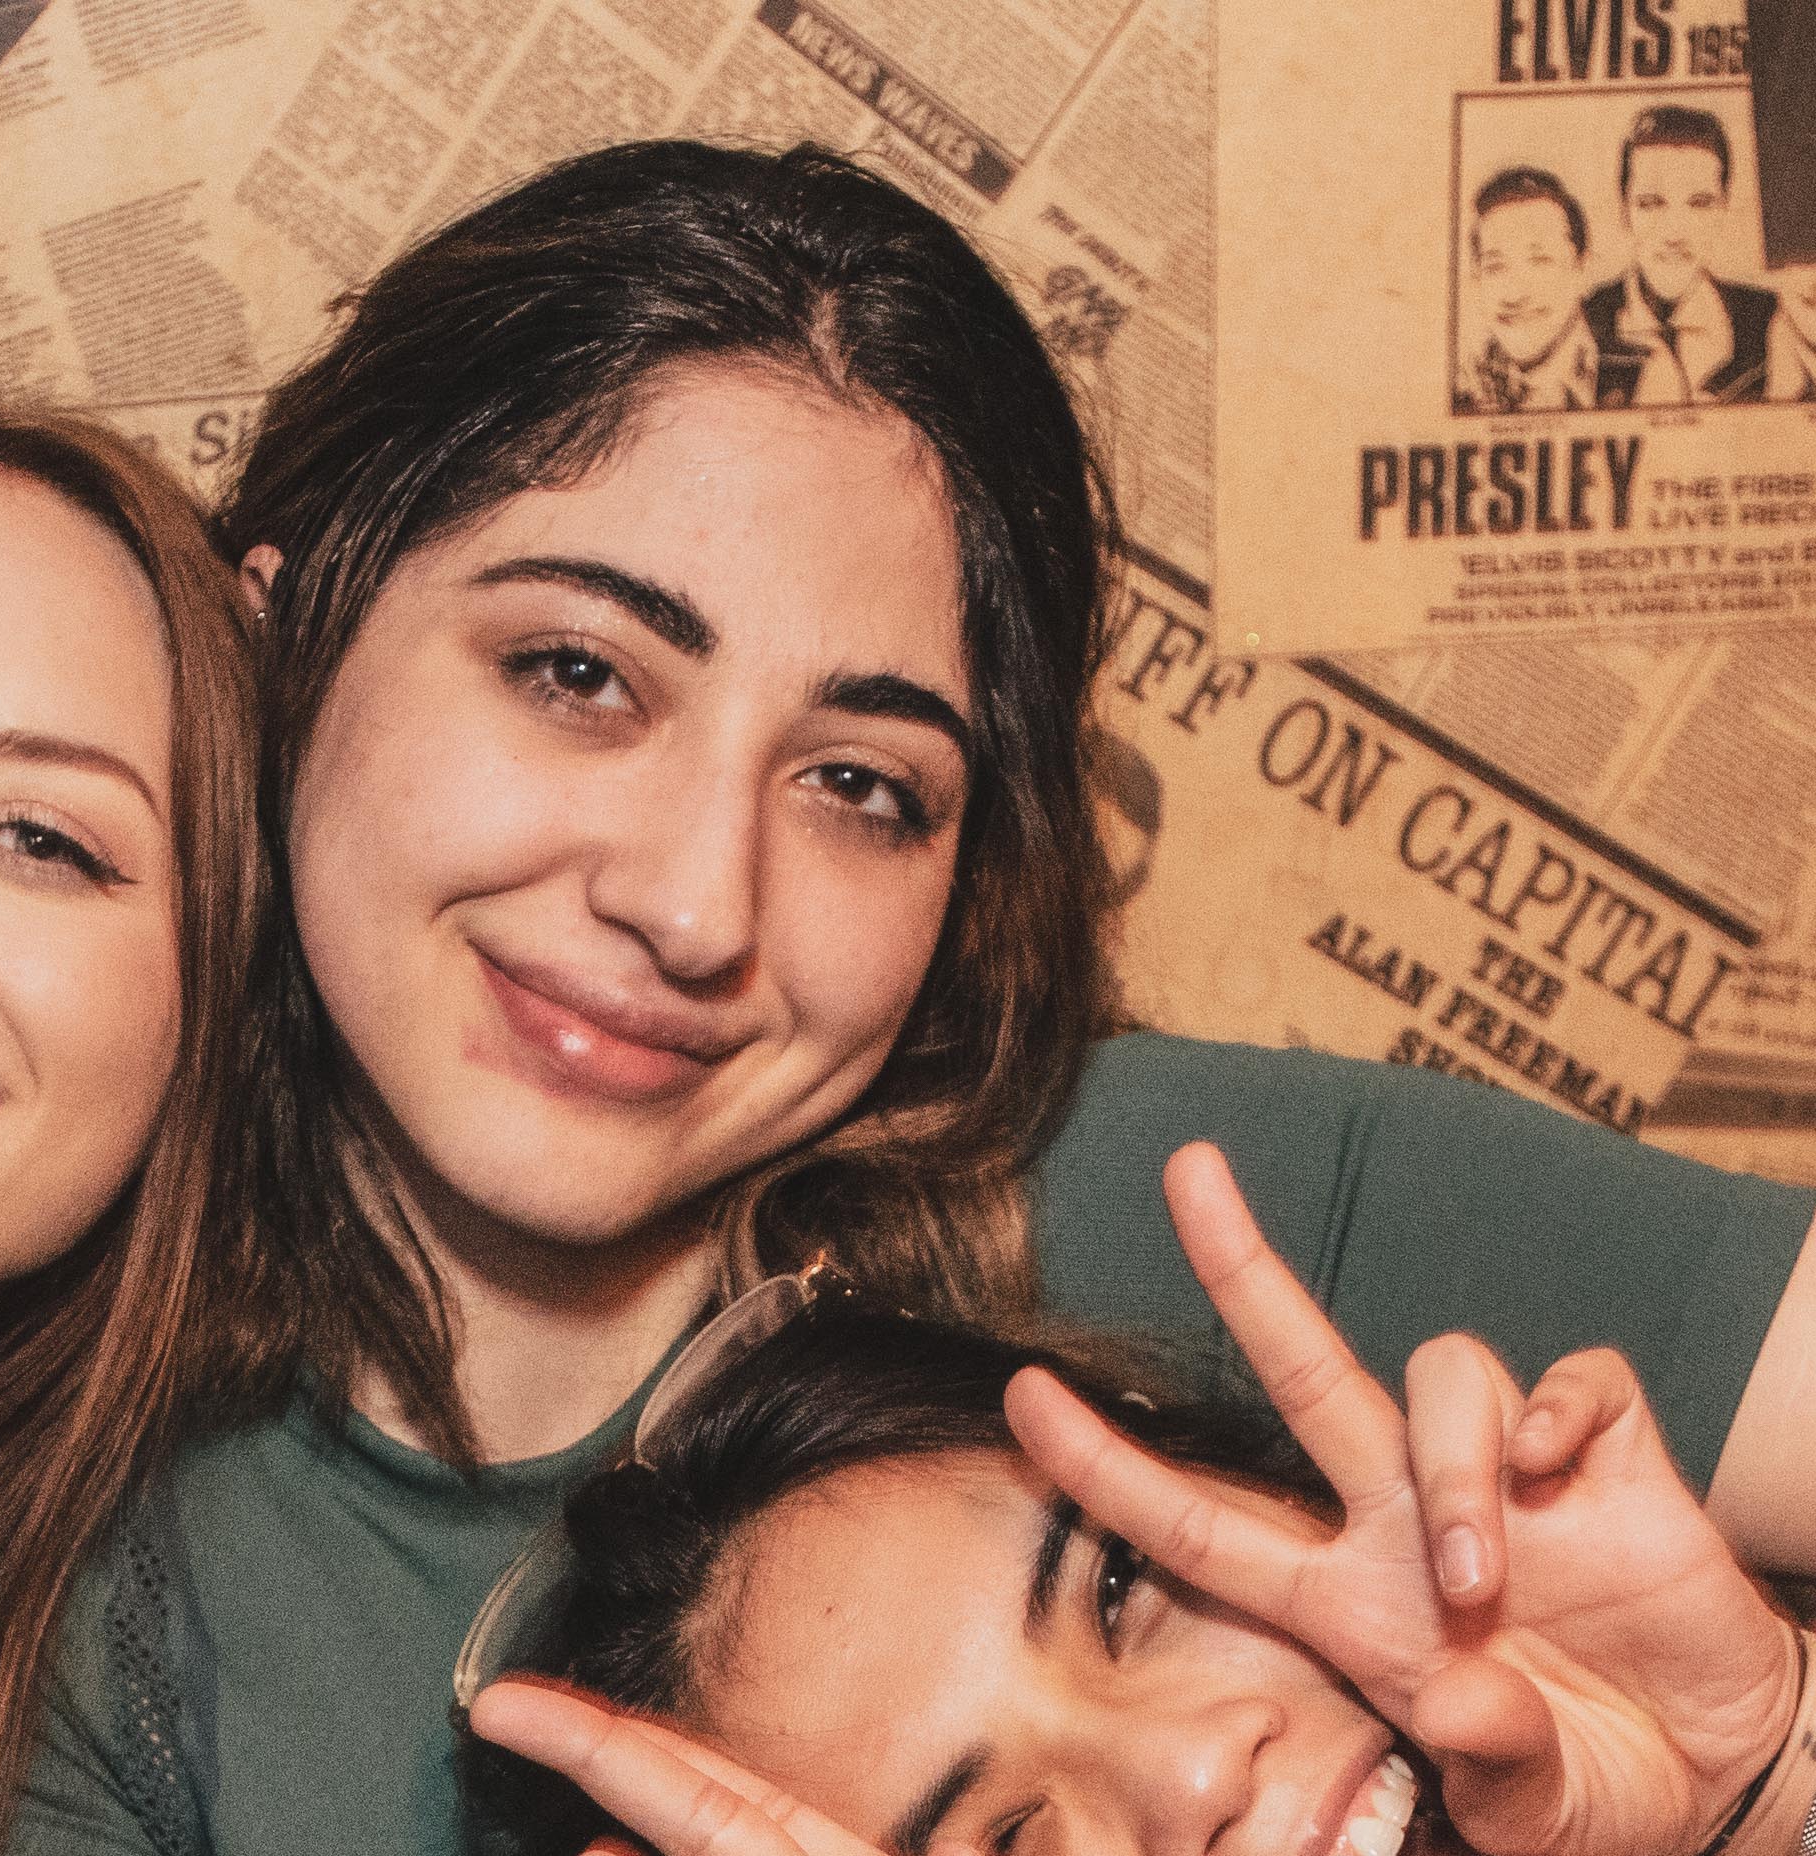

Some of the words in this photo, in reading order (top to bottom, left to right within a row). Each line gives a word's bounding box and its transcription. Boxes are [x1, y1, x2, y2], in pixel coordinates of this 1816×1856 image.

[1496, 0, 1672, 82] ELVIS
[787, 11, 883, 94] NEWS
[877, 78, 981, 171] WAVES
[1358, 434, 1644, 542] PRESLEY
[1650, 504, 1729, 530] LIVE
[1258, 698, 1404, 828] ON
[1306, 913, 1442, 1010] ALAN
[1436, 986, 1647, 1139] FREEMAN
[1470, 935, 1567, 1021] THE
[1386, 1026, 1500, 1087] SH
